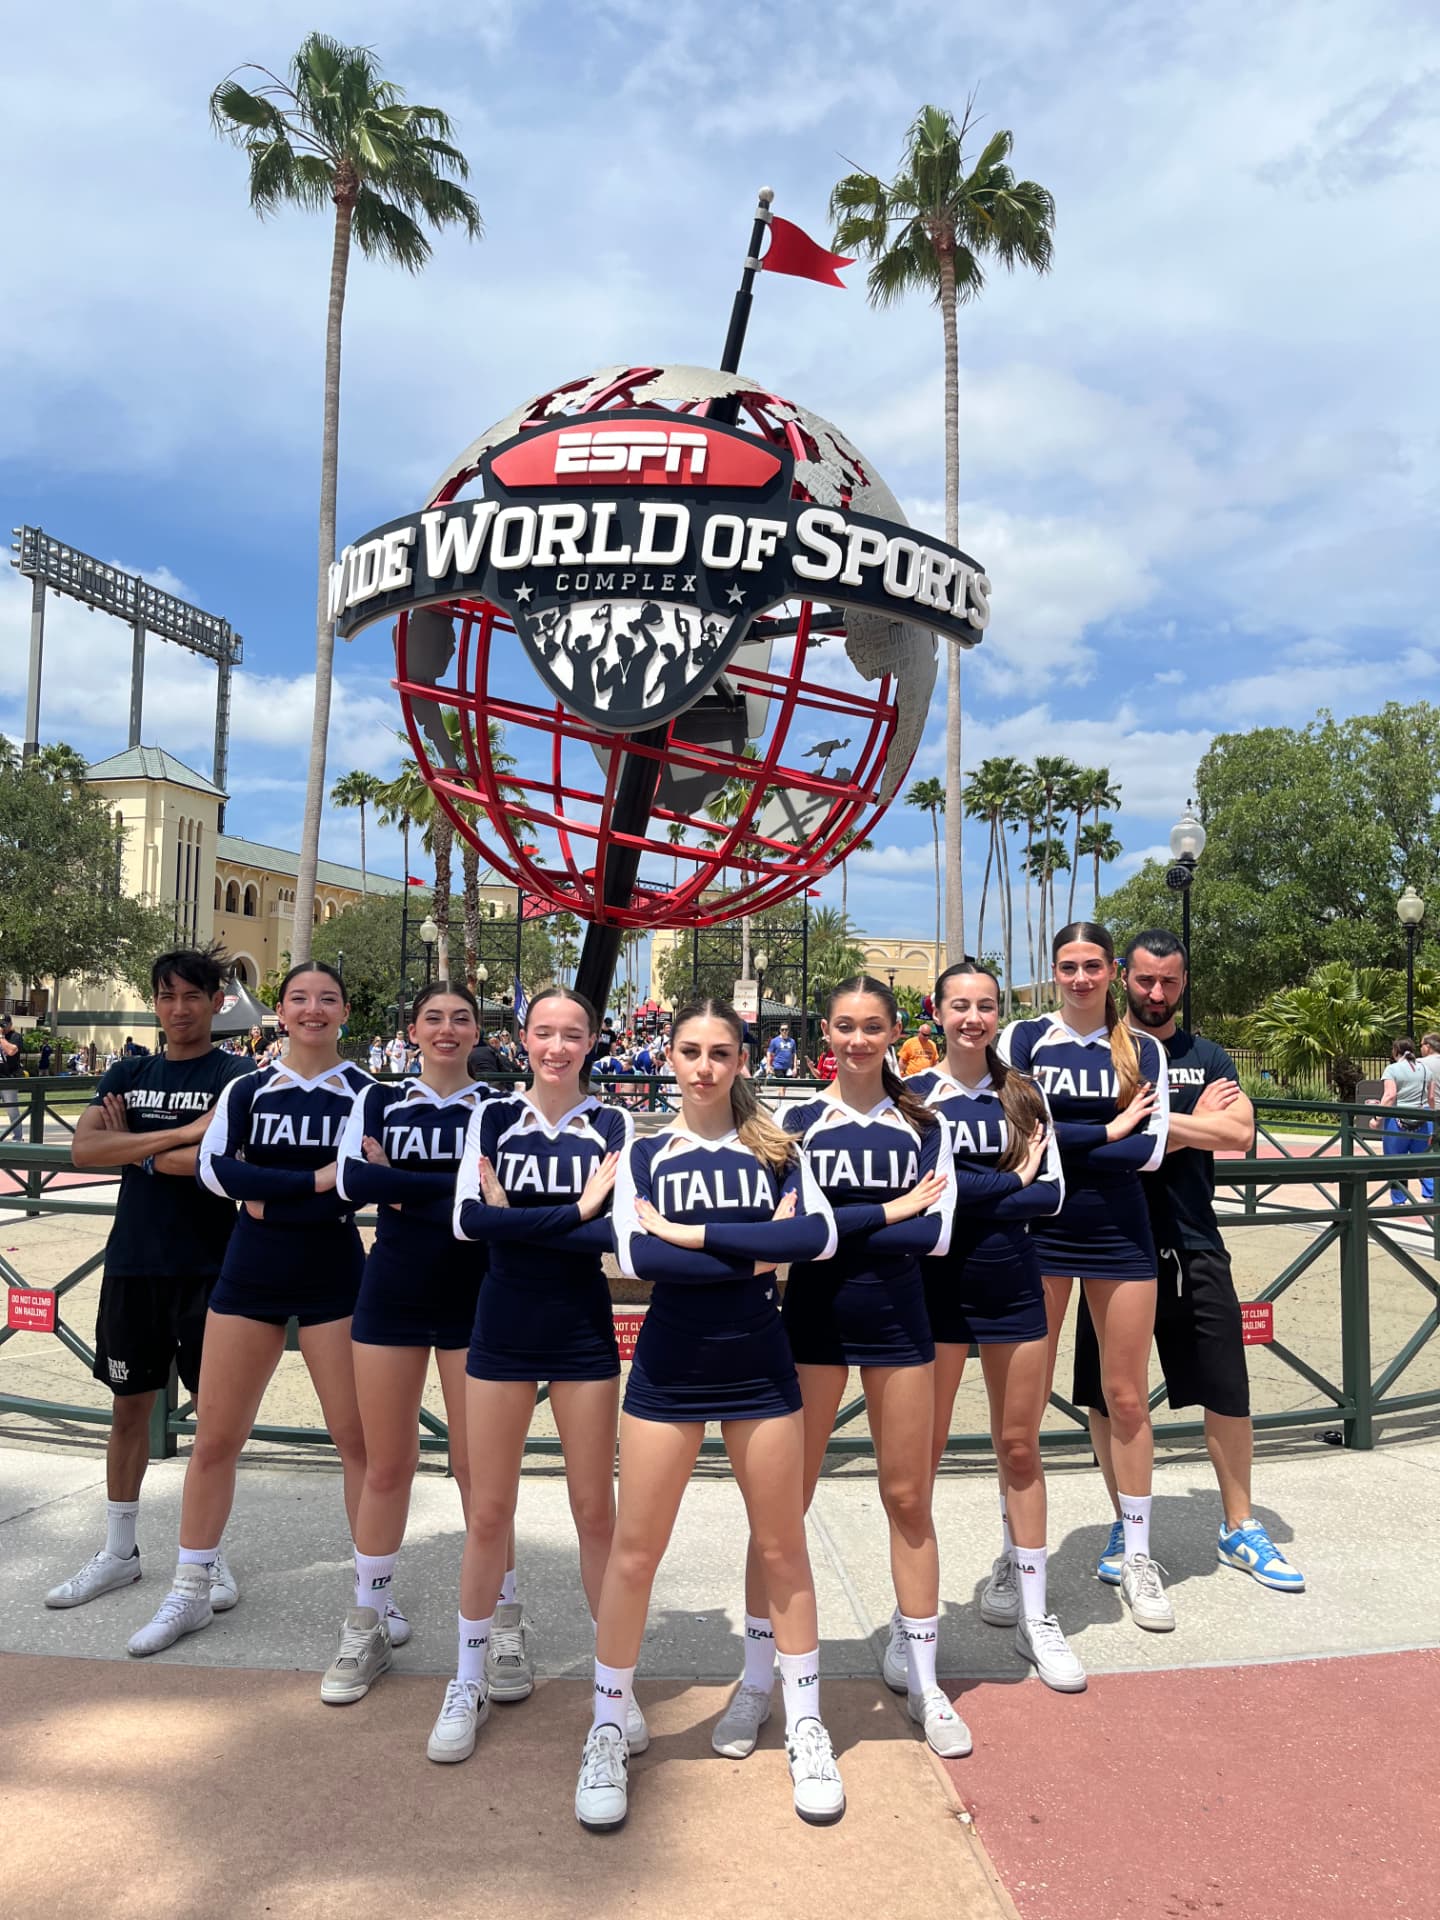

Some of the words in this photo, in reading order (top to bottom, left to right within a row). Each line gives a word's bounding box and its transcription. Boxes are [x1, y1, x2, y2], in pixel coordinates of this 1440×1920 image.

[554, 431, 708, 473] ESPN
[328, 526, 416, 623] WIDE
[421, 500, 690, 579] WORLD
[701, 514, 788, 571] OF
[792, 507, 992, 630] SPORTS
[556, 572, 697, 592] COMPLEX
[1167, 1068, 1205, 1085] TALY
[168, 1091, 213, 1110] ITALY
[804, 1149, 919, 1188] TALIA
[658, 1169, 775, 1215] ITALIA
[11, 1294, 19, 1303] DO
[20, 1295, 31, 1304] NOT
[31, 1296, 51, 1306] CLIMB
[14, 1306, 23, 1315] ON
[24, 1307, 47, 1318] RAILING
[1250, 1309, 1269, 1318] CLIMB
[747, 1627, 775, 1639] ITAL
